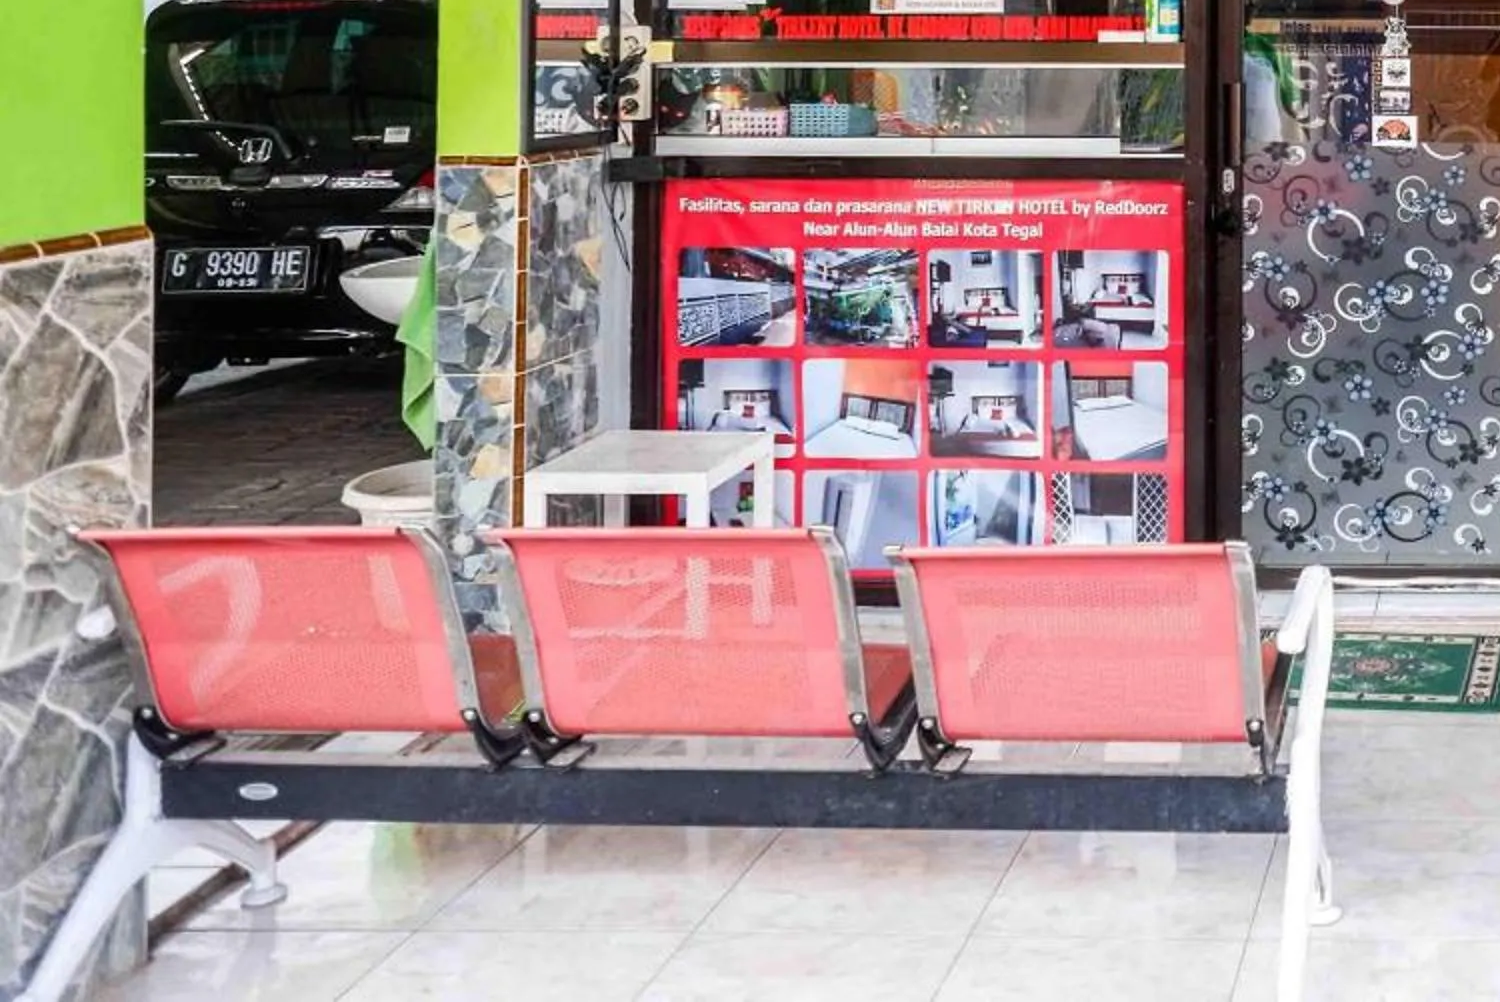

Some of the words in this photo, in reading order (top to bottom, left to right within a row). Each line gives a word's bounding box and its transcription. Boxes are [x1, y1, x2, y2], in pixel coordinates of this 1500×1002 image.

[679, 197, 746, 215] Fasilitas,
[749, 201, 800, 214] sarana
[804, 198, 833, 214] dan
[836, 201, 912, 217] prasarana
[916, 199, 950, 215] NEW
[1018, 199, 1069, 215] HOTEL
[1072, 199, 1090, 218] by
[1095, 200, 1169, 216] RedDoorz
[803, 221, 840, 237] Near
[843, 221, 918, 238] Alun-Alun
[922, 221, 960, 238] Balai
[963, 222, 999, 238] Kota
[1002, 223, 1044, 241] Tegal
[171, 252, 188, 277] G
[205, 251, 259, 276] 9390
[270, 250, 303, 276] HE
